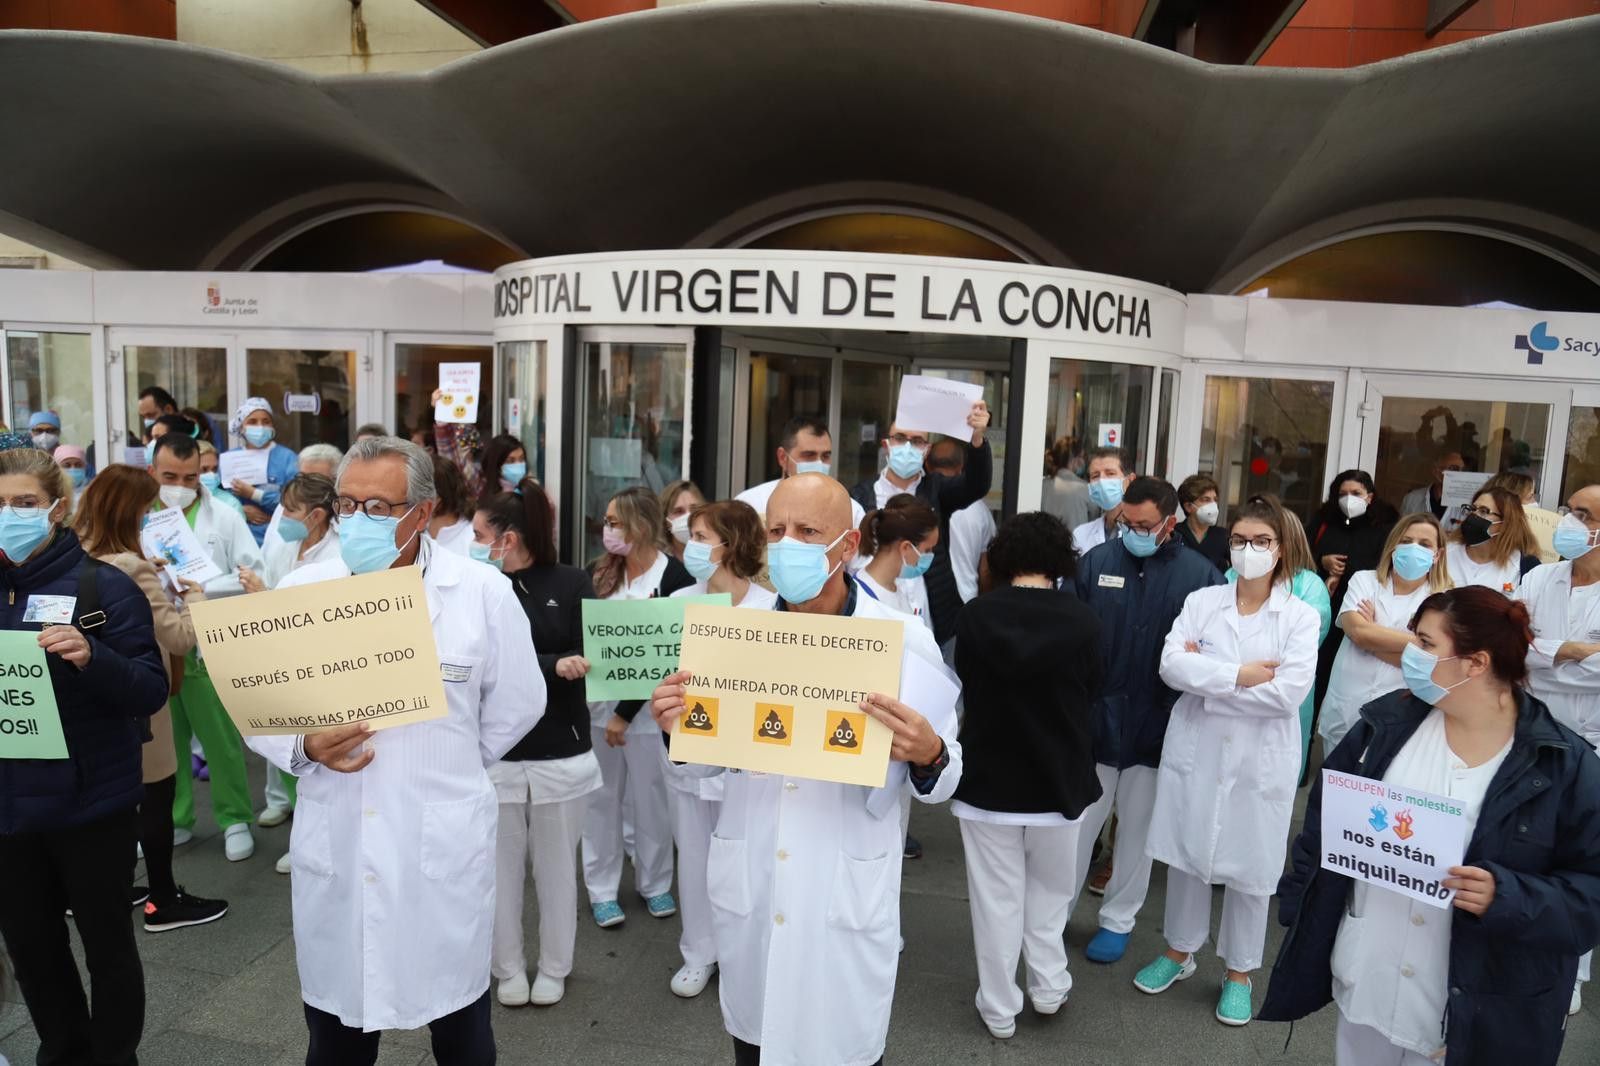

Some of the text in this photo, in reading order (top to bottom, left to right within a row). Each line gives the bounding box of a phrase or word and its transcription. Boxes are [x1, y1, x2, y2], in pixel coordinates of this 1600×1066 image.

[494, 269, 1151, 338] HOSPITAL VIRGEN DE LA CONCHA
[228, 612, 314, 639] VERONICA
[322, 598, 390, 623] CASADO
[588, 624, 663, 637] VERONICA
[690, 623, 888, 653] DESPUES DE LEER EL DECRETO:
[231, 648, 415, 689] DESPUÉS DE DARLO TODO
[714, 677, 767, 694] MIERDA
[771, 683, 799, 697] POR
[802, 686, 871, 704] COMPLET
[268, 717, 287, 727] ASI
[290, 715, 316, 728] NOS
[319, 712, 344, 726] HAS
[347, 699, 404, 720] PAGADO
[1328, 774, 1462, 816] DISCULPEN las molestias
[1343, 828, 1435, 867] nos están
[1327, 852, 1450, 901] aniquilando
